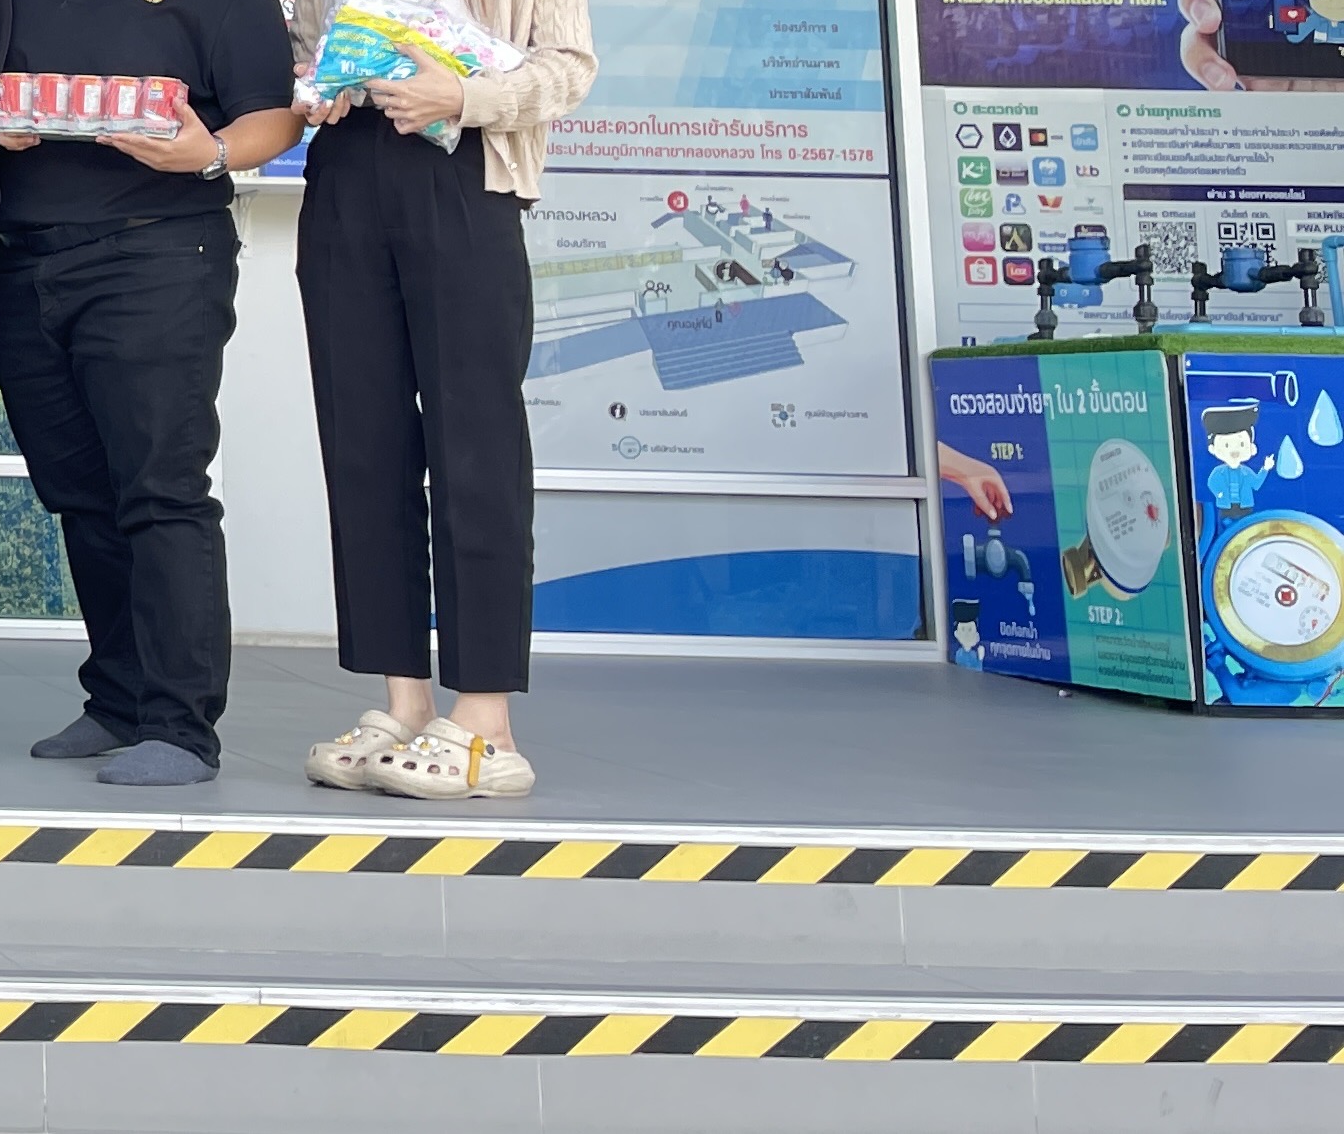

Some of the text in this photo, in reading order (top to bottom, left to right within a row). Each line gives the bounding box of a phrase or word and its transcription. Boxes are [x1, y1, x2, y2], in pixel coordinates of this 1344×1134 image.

[769, 86, 843, 103] ประชาสัมพันธ์
[548, 114, 809, 141] ความสะดวกในการเข้ารับบริการ
[546, 142, 874, 163] ประปาส่วนภูมิภาคสาขาคลองหลวง โทร 0-2567-1578
[1229, 190, 1236, 199] 3
[525, 209, 617, 222] าขาคลองหลวง
[1076, 392, 1088, 415] 2
[1090, 378, 1148, 414] ขั้นตอน
[990, 442, 1014, 460] STEP
[1088, 605, 1113, 624] STEP
